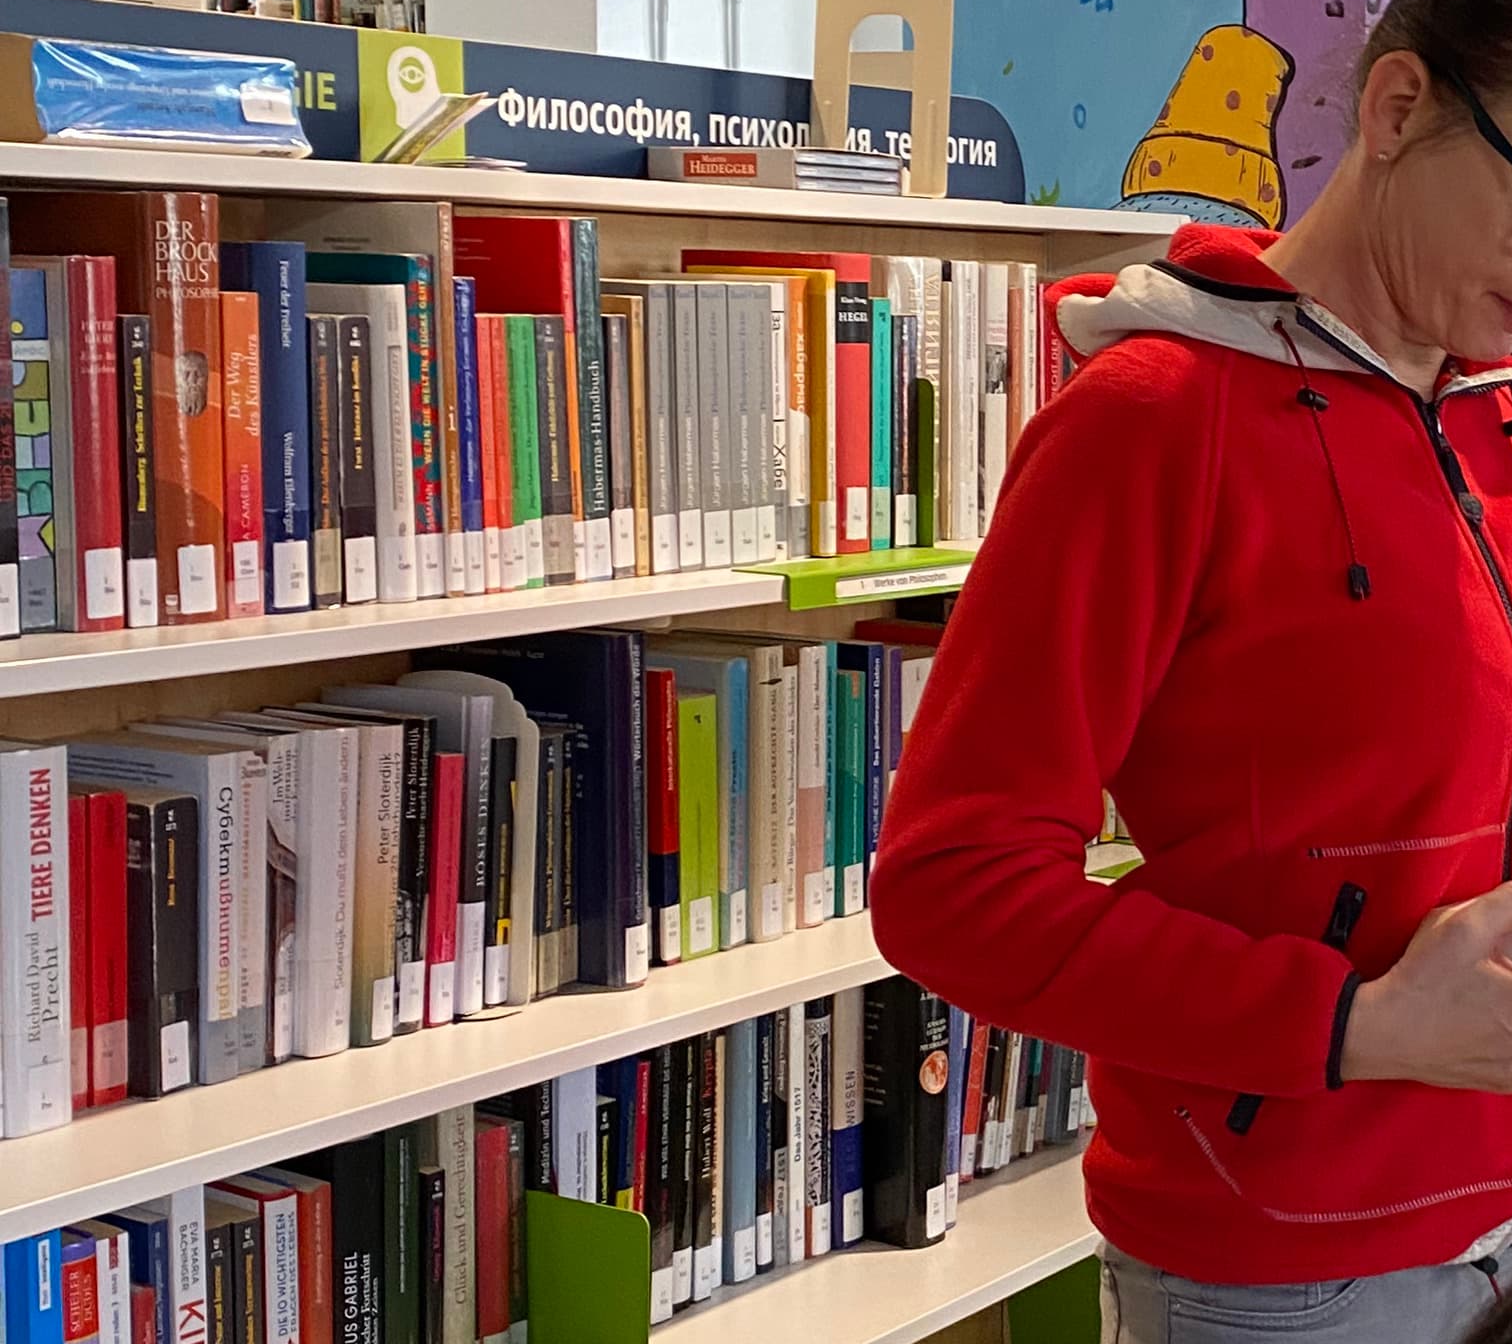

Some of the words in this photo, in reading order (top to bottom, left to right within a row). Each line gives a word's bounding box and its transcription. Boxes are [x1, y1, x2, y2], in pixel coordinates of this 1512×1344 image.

[497, 87, 701, 146] Философия,
[689, 160, 757, 175] HEIDEGGER
[155, 219, 196, 241] DER
[154, 240, 218, 262] BROCK
[154, 261, 210, 283] HAUS
[279, 260, 289, 288] Feuer
[280, 290, 290, 307] der
[280, 309, 292, 348] Freiheit
[838, 310, 869, 323] HEGEL
[227, 352, 244, 384] Weg
[242, 333, 258, 406] Künstlers
[420, 359, 429, 371] IN
[227, 392, 241, 417] Der
[420, 375, 431, 404] WELT
[246, 411, 259, 436] des
[422, 407, 431, 426] DIE
[423, 430, 433, 464] WENN
[588, 360, 606, 513] Habermas-Handbuch
[773, 444, 786, 489] Хабе
[873, 577, 896, 588] Werke
[908, 572, 948, 586] Philosophen
[406, 727, 421, 785] Sloterdijk
[872, 750, 880, 767] Das
[377, 753, 392, 822] Sloterdijk
[477, 736, 490, 817] DENKEN
[273, 786, 284, 803] Im
[405, 789, 417, 819] Peter
[29, 767, 52, 855] DENKEN
[377, 827, 389, 864] Peter
[30, 861, 53, 922] TIERE
[336, 902, 345, 922] Du
[24, 932, 40, 977] David
[41, 945, 59, 1023] Precht
[25, 981, 41, 1042] Richard
[703, 1049, 713, 1098] Krypta
[541, 1118, 550, 1139] und
[702, 1107, 712, 1134] Wolf
[793, 1115, 801, 1140] Jahr
[452, 1114, 467, 1219] Gerechtigkeit
[540, 1142, 550, 1184] Medizin
[793, 1141, 802, 1163] Das
[189, 1222, 198, 1244] EVA
[454, 1223, 466, 1254] und
[179, 1224, 190, 1292] BACHINGER
[190, 1246, 200, 1284] MARIA
[275, 1214, 287, 1298] WICHTIGSTEN
[344, 1251, 358, 1319] GABRIEL
[360, 1254, 371, 1312] Fortschritt
[454, 1259, 467, 1305] Glück
[277, 1317, 288, 1336] DIE
